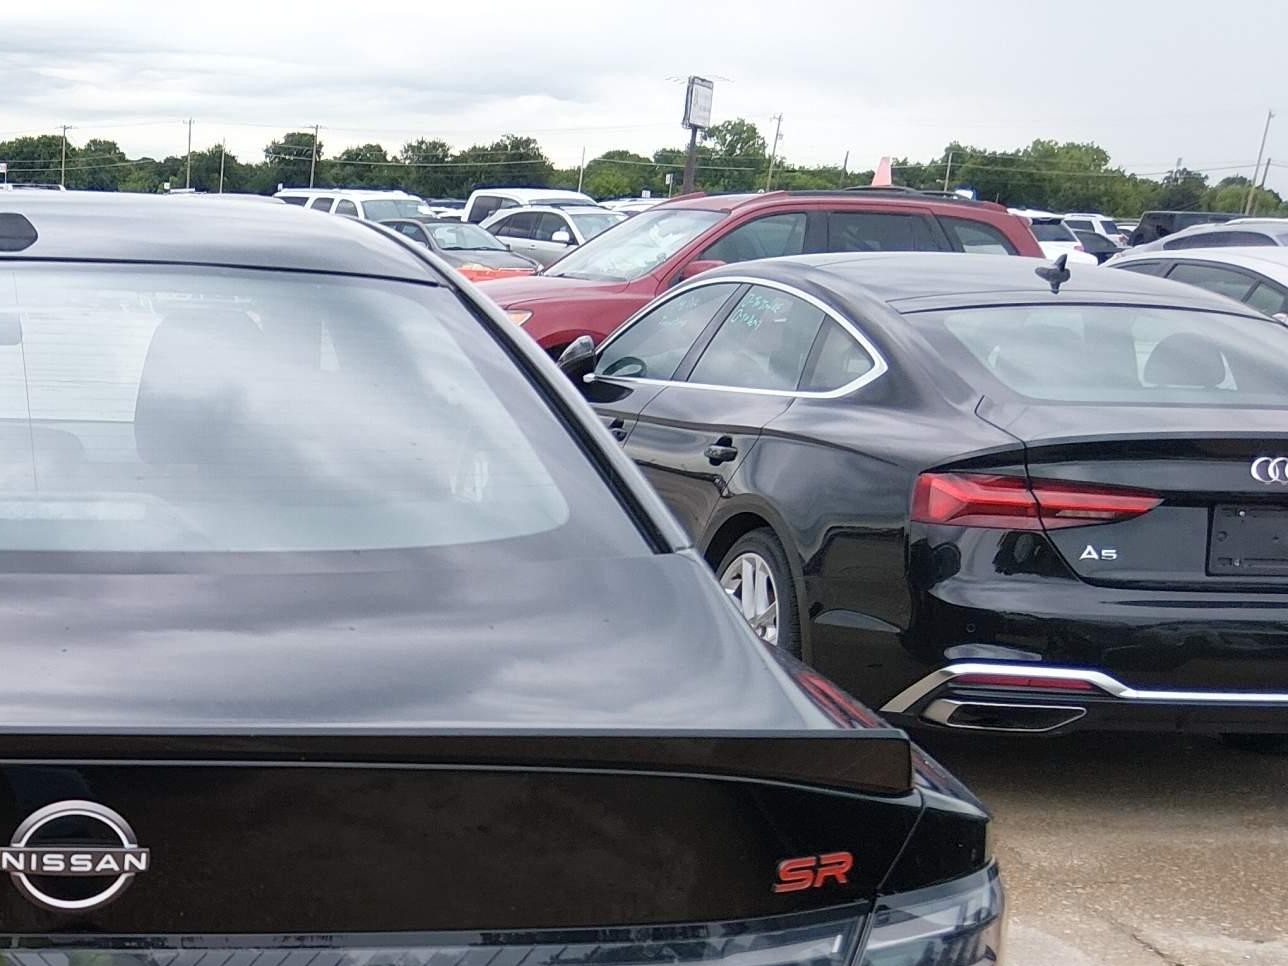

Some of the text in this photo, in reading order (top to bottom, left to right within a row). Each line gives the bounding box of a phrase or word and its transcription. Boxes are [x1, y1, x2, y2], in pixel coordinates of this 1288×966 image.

[1079, 545, 1117, 560] A5
[2, 852, 146, 872] NISSAN
[774, 851, 853, 893] SR
